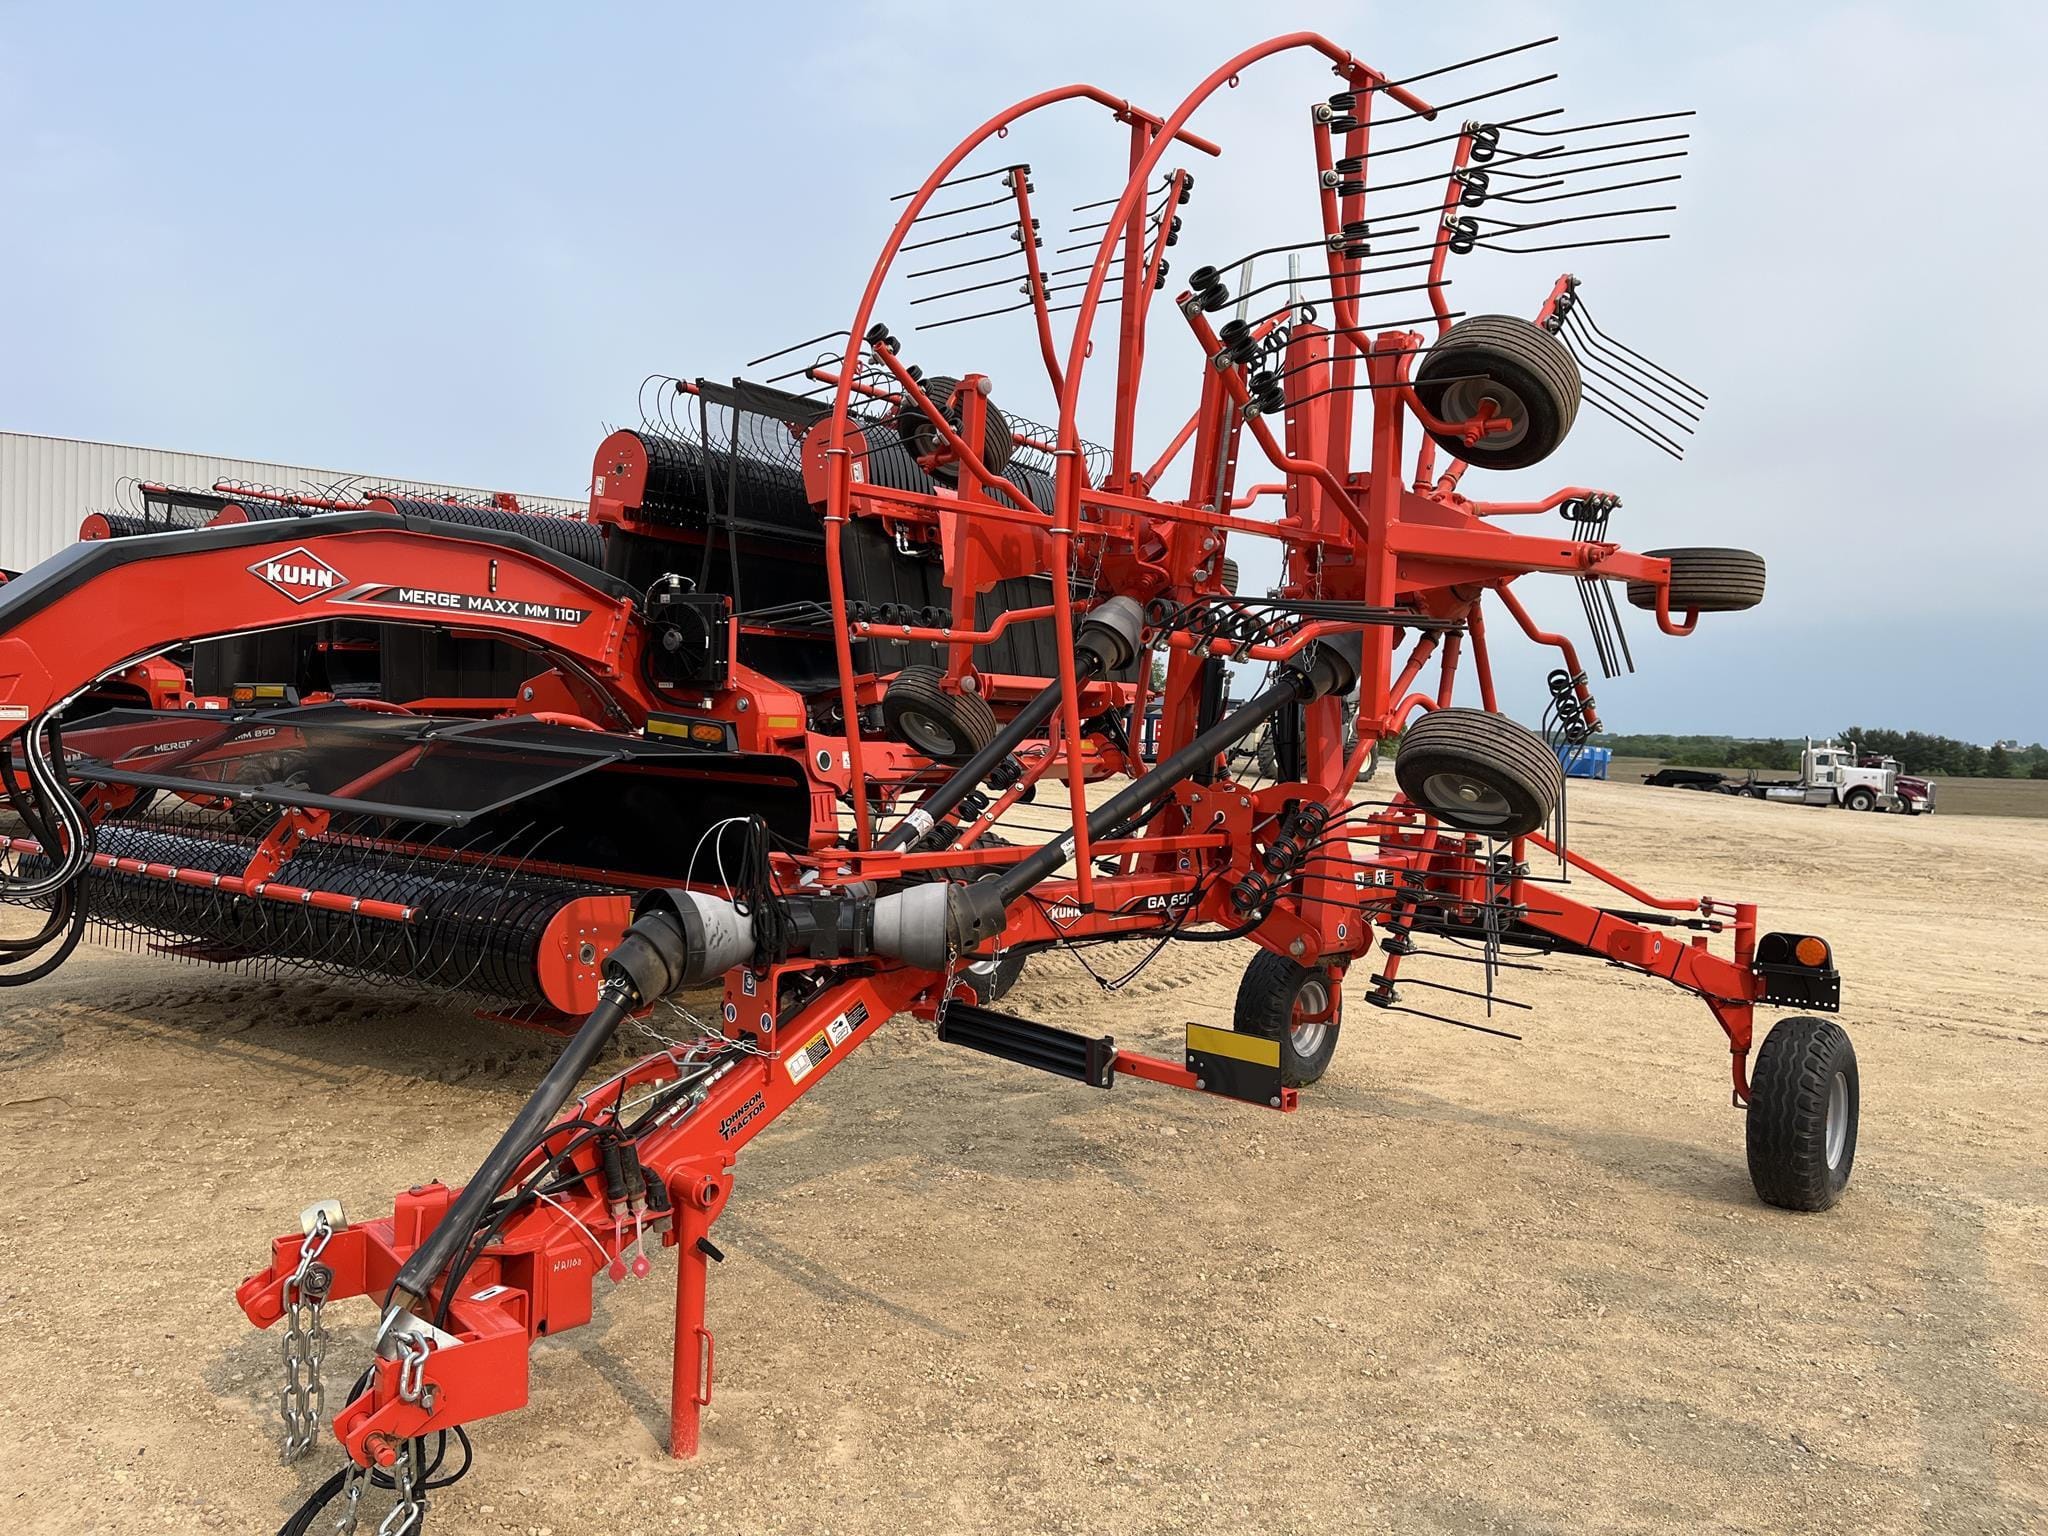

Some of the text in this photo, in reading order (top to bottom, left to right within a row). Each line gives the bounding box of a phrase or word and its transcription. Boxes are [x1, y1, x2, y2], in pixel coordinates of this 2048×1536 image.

[267, 562, 333, 588] KUHN
[399, 588, 581, 622] MERGE MAXX MM 1101
[254, 727, 276, 739] 890
[1147, 895, 1167, 909] GA
[719, 1091, 762, 1133] JOHNSON
[722, 1101, 766, 1141] TRACTOR
